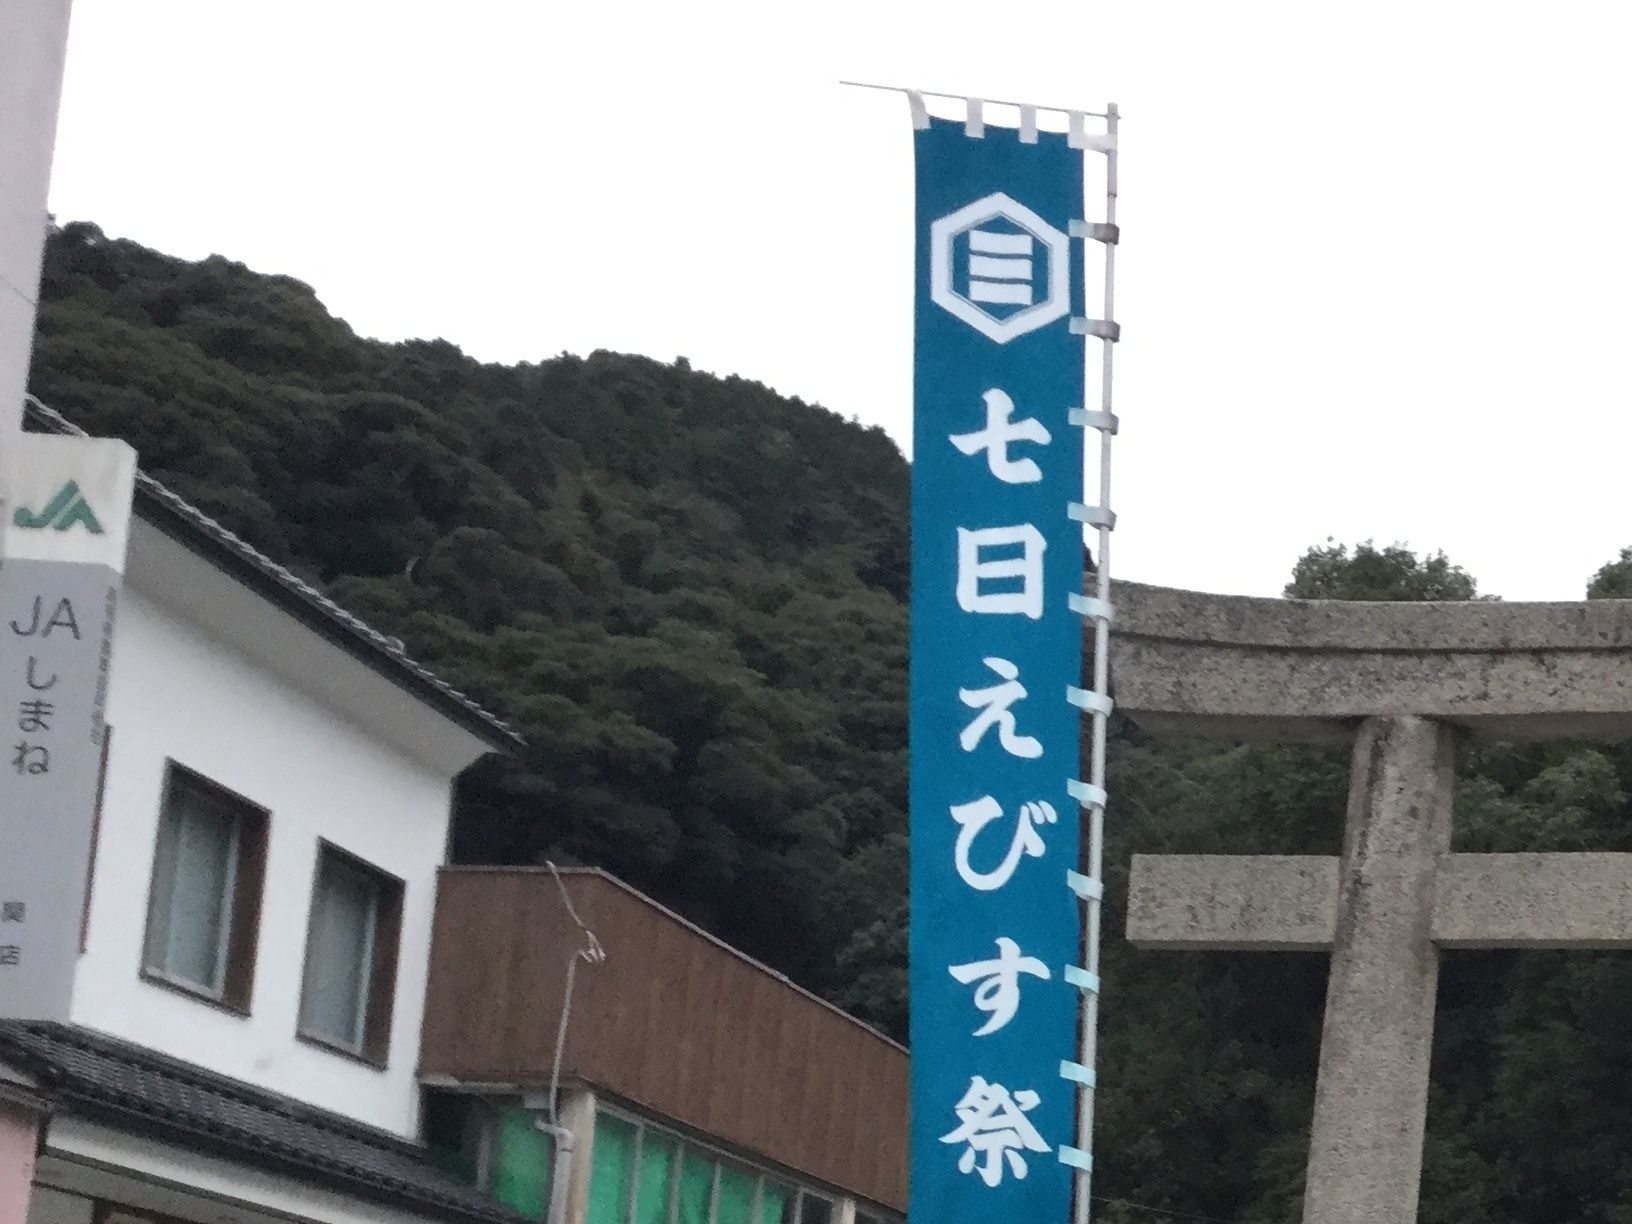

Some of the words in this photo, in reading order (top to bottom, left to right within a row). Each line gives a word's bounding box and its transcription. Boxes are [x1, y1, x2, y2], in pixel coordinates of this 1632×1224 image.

[9, 596, 81, 775] JAしまね
[938, 388, 1057, 1187] 七日えびす祭
